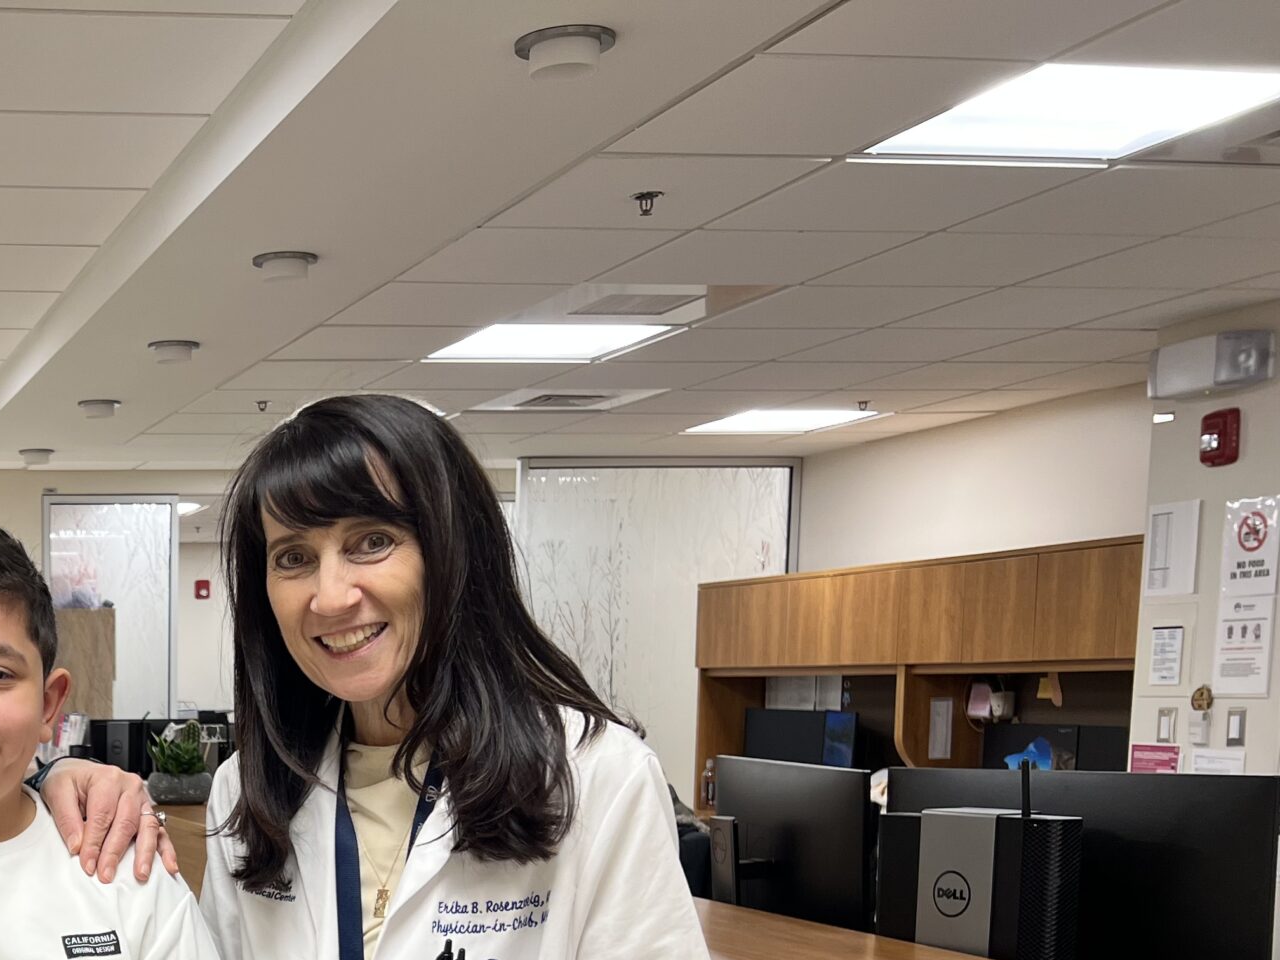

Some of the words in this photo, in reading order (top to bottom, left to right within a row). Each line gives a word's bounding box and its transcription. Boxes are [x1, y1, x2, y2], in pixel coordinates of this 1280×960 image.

[1236, 561, 1246, 569] NO
[1248, 559, 1265, 568] FOOD
[1230, 572, 1237, 580] IN
[1254, 568, 1270, 578] AREA
[937, 887, 966, 901] DELL
[437, 900, 469, 914] Erika
[471, 901, 482, 914] B.
[65, 933, 116, 945] CALIFORNIA
[72, 946, 95, 954] ORIGINAL
[96, 945, 115, 954] DESIGN
